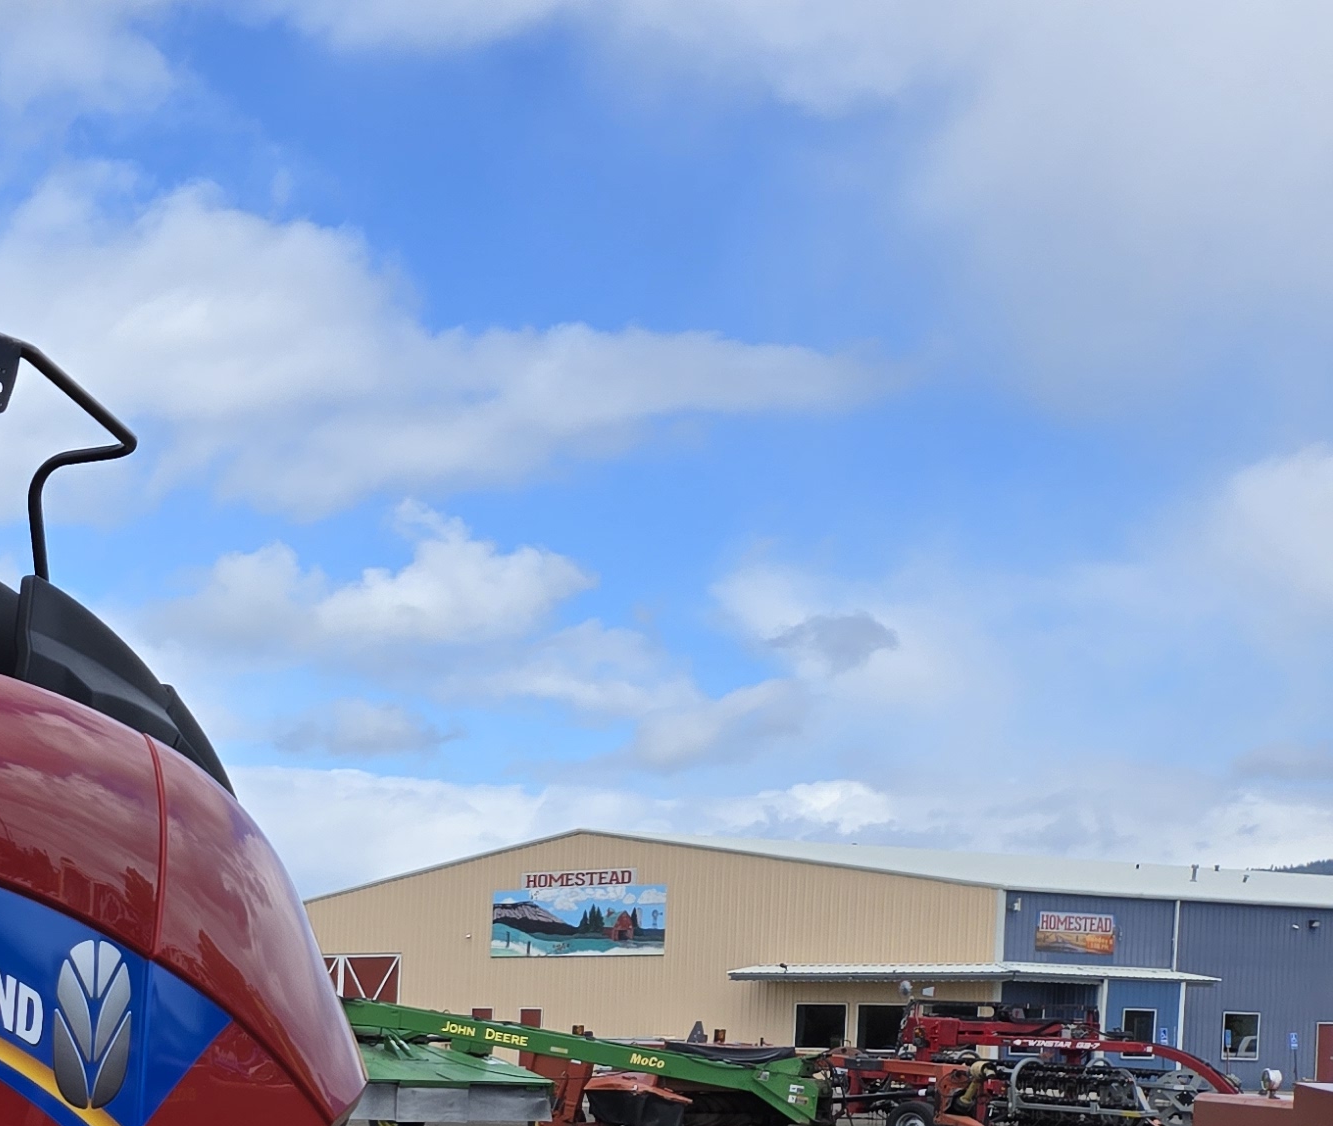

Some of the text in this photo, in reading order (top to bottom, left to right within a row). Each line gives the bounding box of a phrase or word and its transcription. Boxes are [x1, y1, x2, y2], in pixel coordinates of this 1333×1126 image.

[525, 870, 632, 888] HOMESTEAD
[1041, 914, 1112, 932] HOMESTEAD
[441, 1021, 529, 1047] JOHN DEERE
[630, 1053, 665, 1069] MoCo
